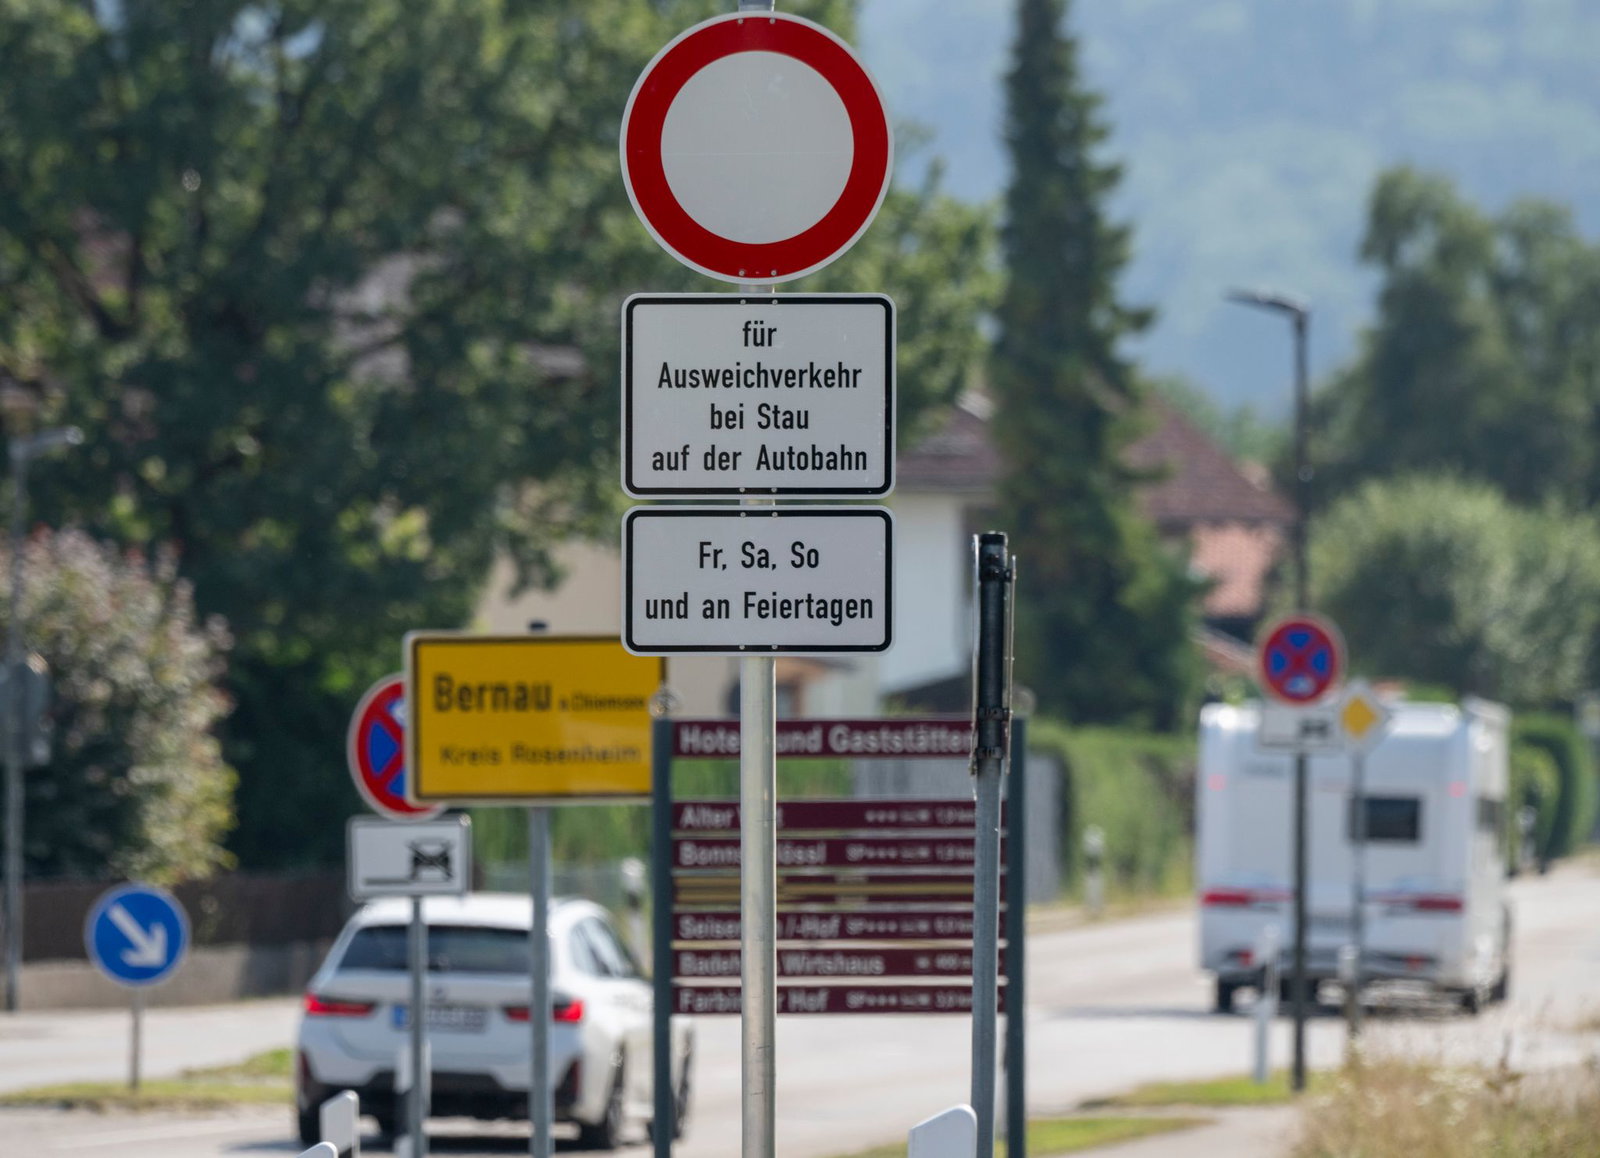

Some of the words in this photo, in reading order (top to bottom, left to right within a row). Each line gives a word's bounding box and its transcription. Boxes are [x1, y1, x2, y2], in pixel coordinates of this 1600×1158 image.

[742, 320, 777, 348] für
[657, 361, 863, 389] Ausweichverkehr
[710, 403, 745, 430] bei
[757, 403, 809, 430] Stau
[651, 444, 690, 471] auf
[703, 444, 742, 471] der
[756, 444, 868, 471] Autobahn
[699, 541, 727, 571] Fr,
[740, 541, 777, 571] Sa,
[790, 541, 820, 569] So
[645, 592, 689, 619] und
[702, 598, 730, 619] an
[743, 591, 874, 627] Feiertagen
[434, 673, 552, 712] Bernau
[440, 746, 502, 766] Kreis
[511, 743, 641, 765] Rosenheim
[780, 951, 886, 975] Wirtshaus
[787, 988, 830, 1012] Hof
